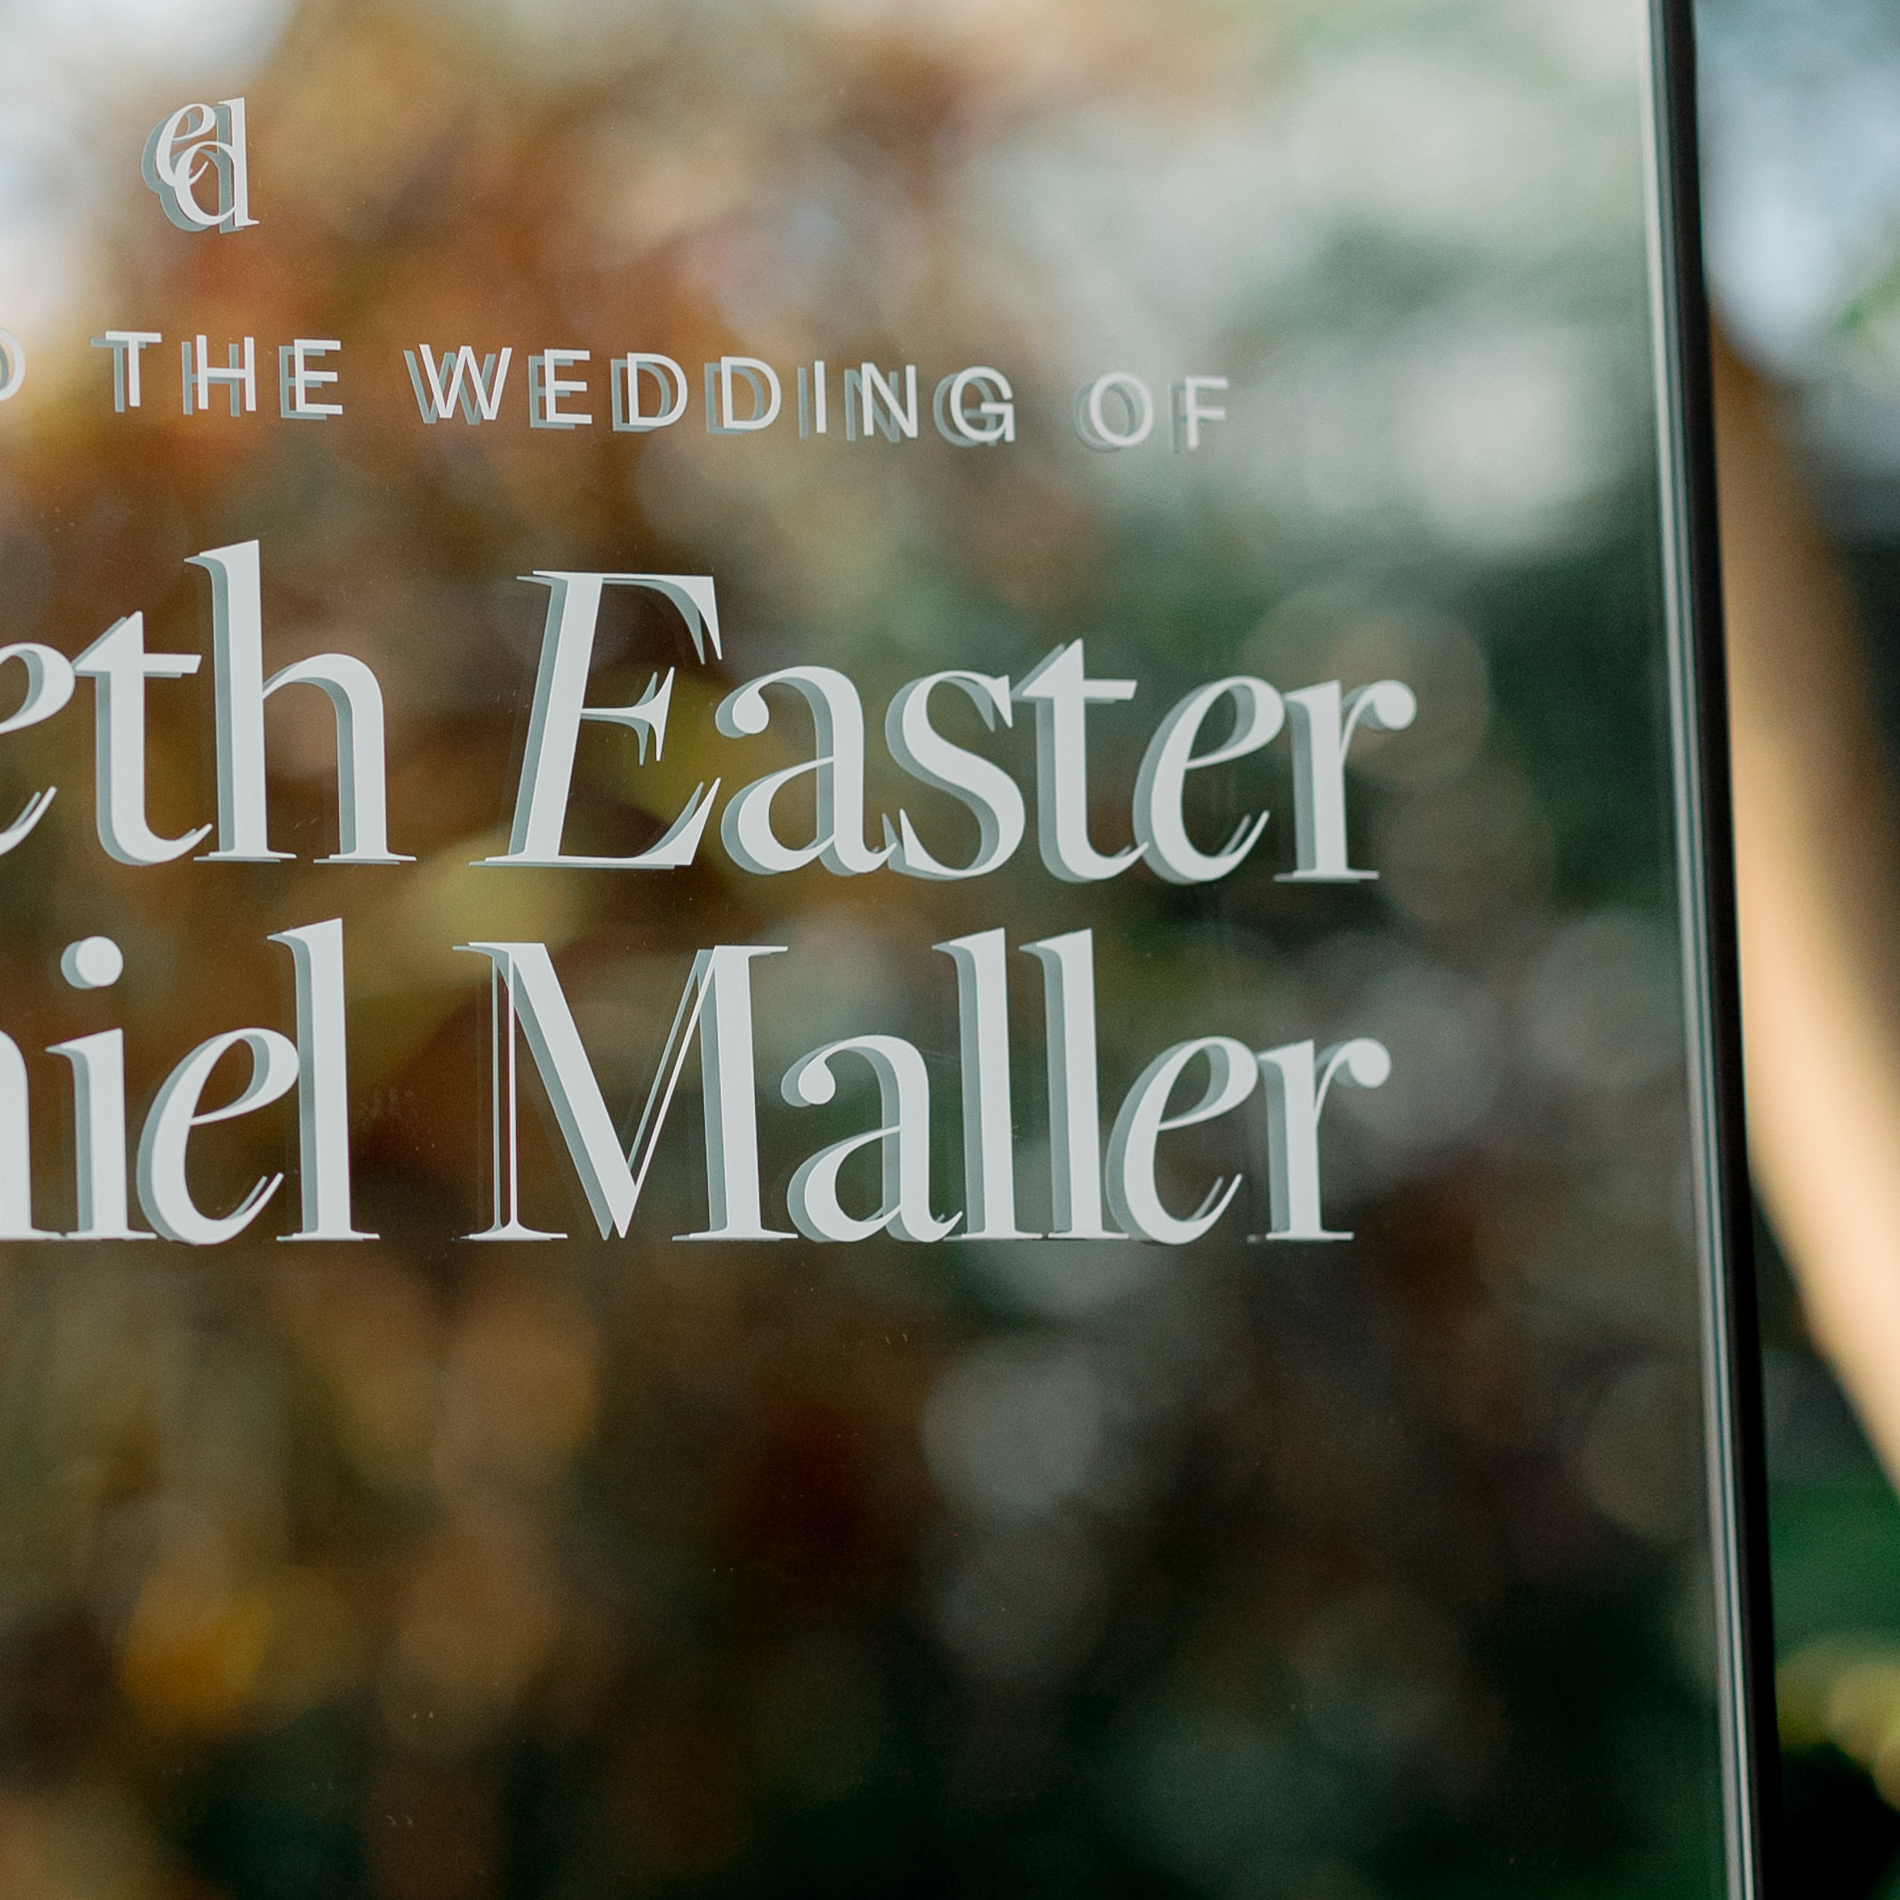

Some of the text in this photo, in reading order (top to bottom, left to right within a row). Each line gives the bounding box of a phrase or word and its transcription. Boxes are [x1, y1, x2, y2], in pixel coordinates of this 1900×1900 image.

[103, 329, 345, 418] THE
[416, 342, 1017, 444] WEDDING
[1084, 371, 1230, 450] OF
[473, 569, 1418, 883] Easter
[460, 927, 1392, 1245] Maller
